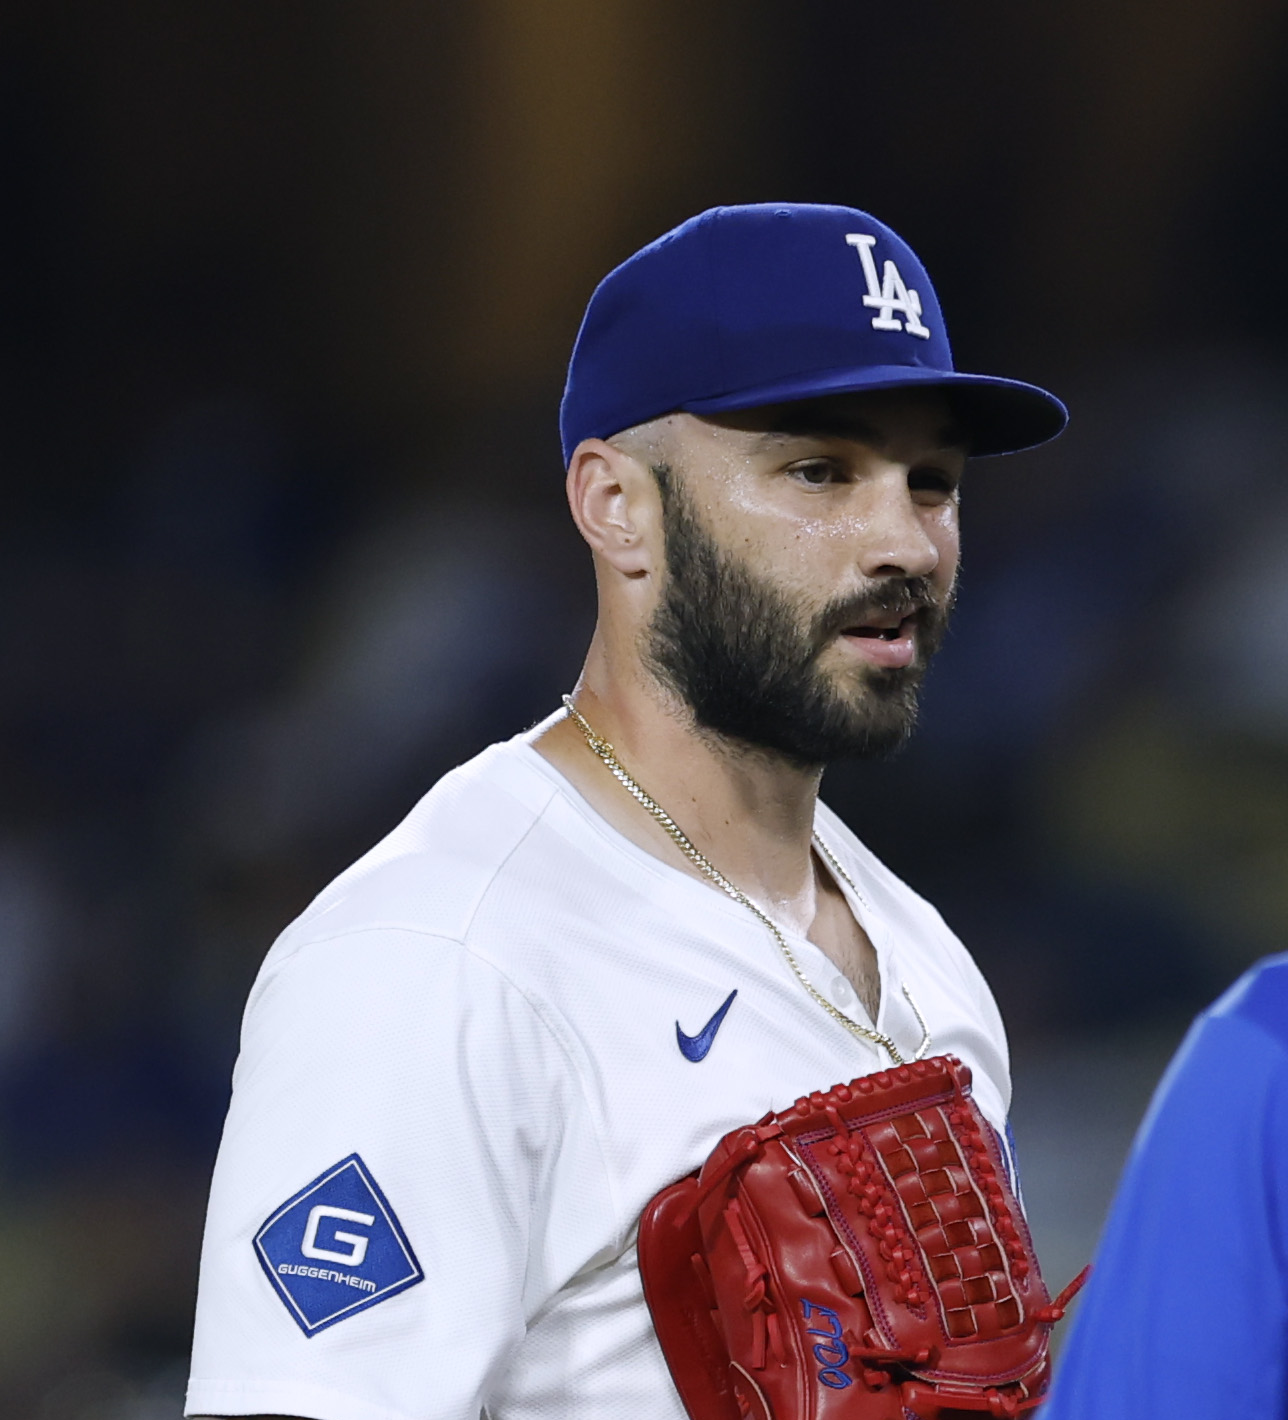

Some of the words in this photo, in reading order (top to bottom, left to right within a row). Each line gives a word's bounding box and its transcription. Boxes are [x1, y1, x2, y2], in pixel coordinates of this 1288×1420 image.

[845, 233, 930, 339] LA
[301, 1205, 376, 1267] G
[277, 1263, 377, 1292] GUGGENHEIM
